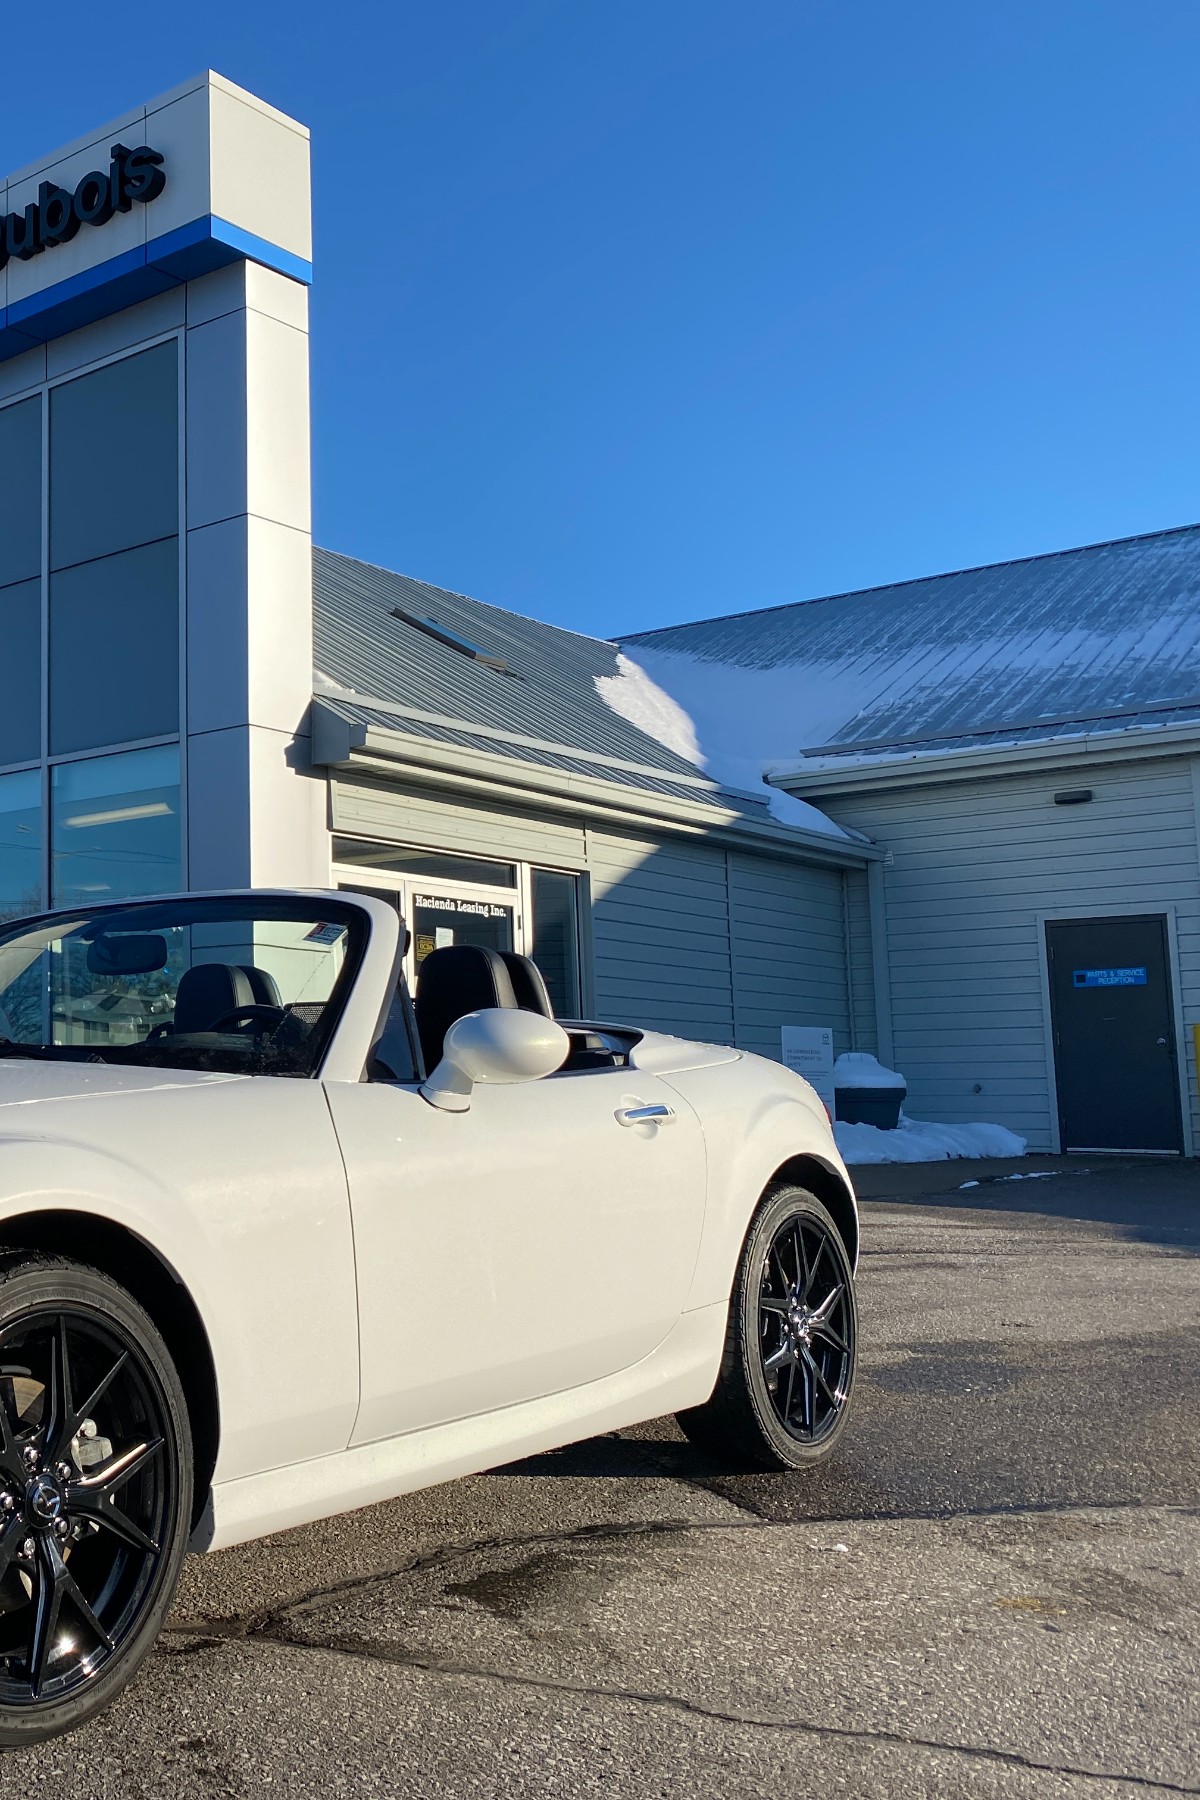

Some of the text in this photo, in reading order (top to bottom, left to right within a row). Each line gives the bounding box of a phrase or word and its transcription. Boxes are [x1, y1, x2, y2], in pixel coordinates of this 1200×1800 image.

[415, 894, 507, 918] Hacienda Leasing Inc.
[1086, 970, 1108, 978] PARTS
[1117, 968, 1144, 977] SERVICE
[1098, 976, 1135, 984] RECEPTION
